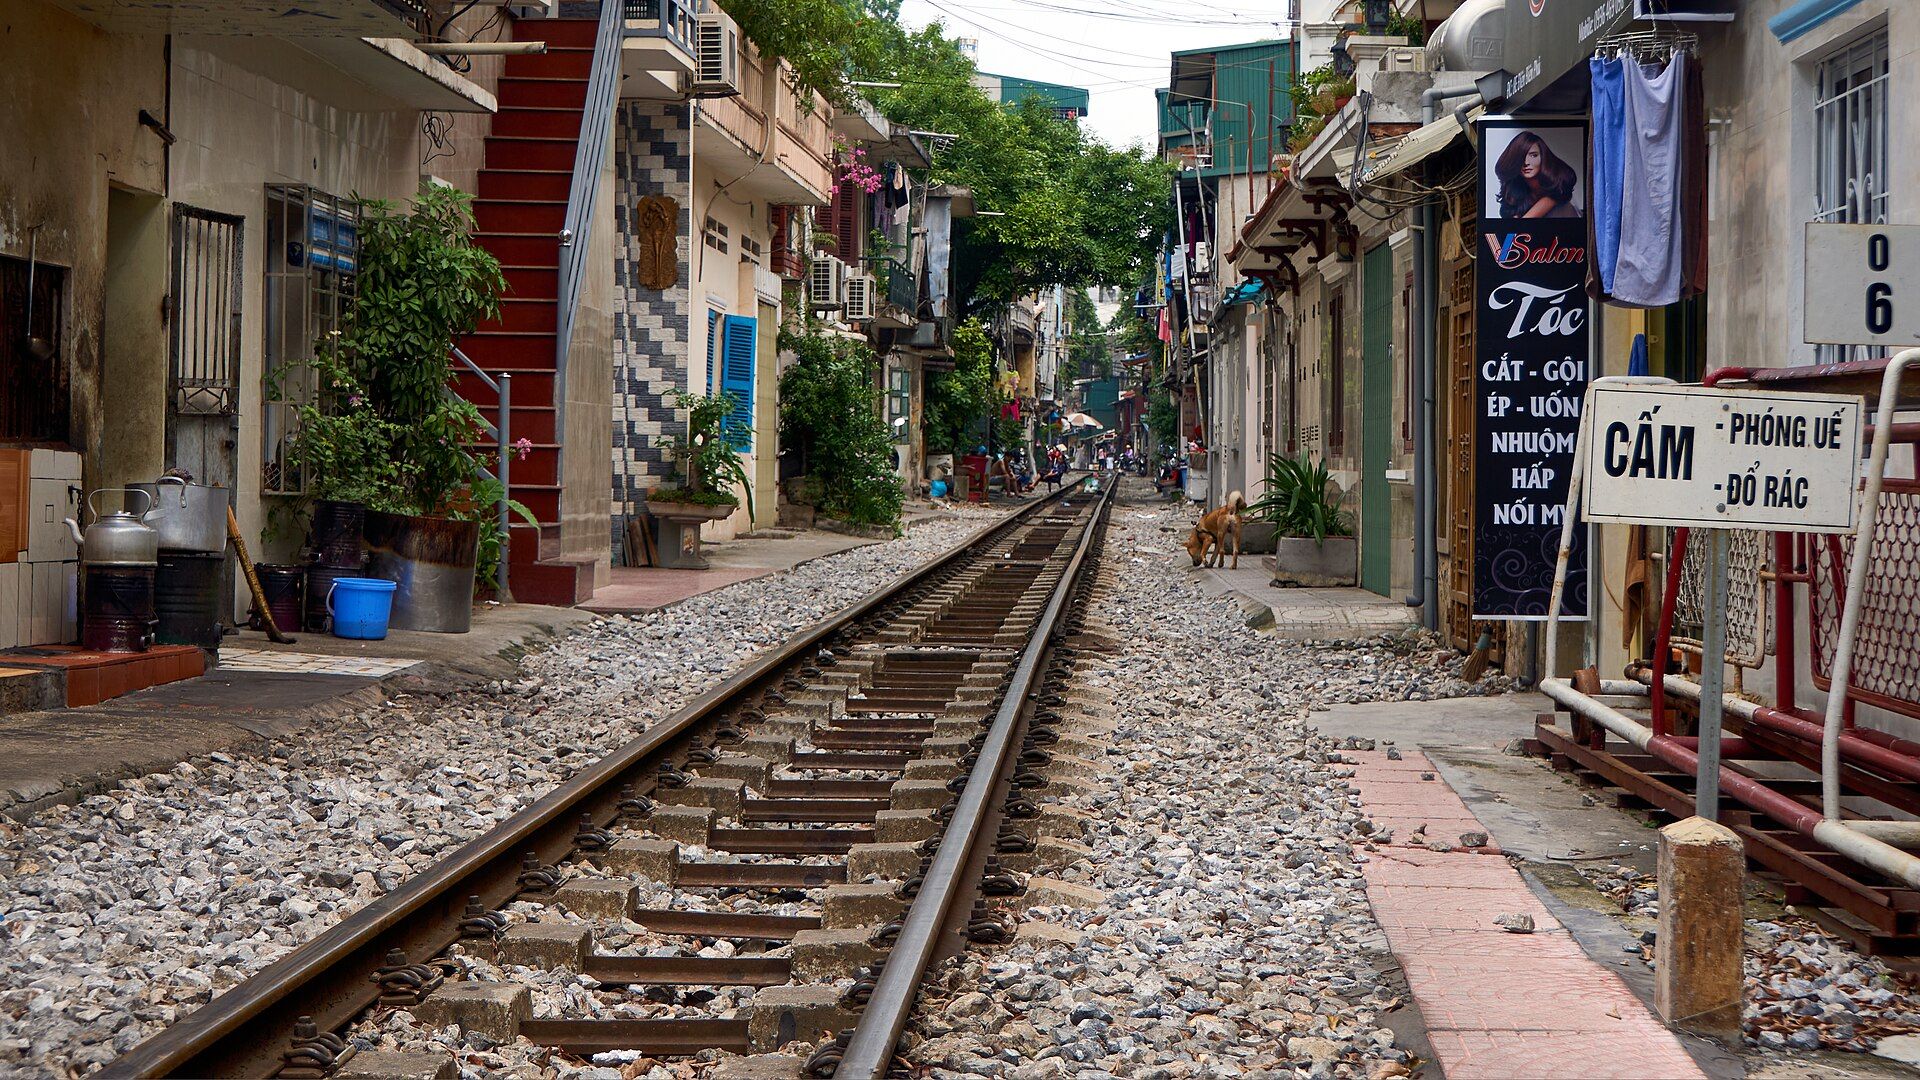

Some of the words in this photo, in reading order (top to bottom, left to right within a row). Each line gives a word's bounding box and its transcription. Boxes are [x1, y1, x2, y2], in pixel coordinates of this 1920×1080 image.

[1867, 233, 1889, 272] 0
[1488, 281, 1584, 339] Tóc
[1865, 282, 1892, 334] 6
[1482, 352, 1524, 382] CẮT
[1543, 356, 1584, 386] GỘI
[1487, 391, 1511, 417] ÉP
[1530, 389, 1579, 418] UỐN
[1491, 427, 1575, 458] NHUỘM
[1604, 405, 1695, 481] CẤM
[1729, 406, 1806, 448] PHÓNG
[1813, 407, 1846, 450] UẾ
[1511, 461, 1555, 489] HẤP
[1726, 461, 1760, 506] ĐỔ
[1763, 469, 1809, 509] RÁC
[1493, 496, 1534, 525] NỐI
